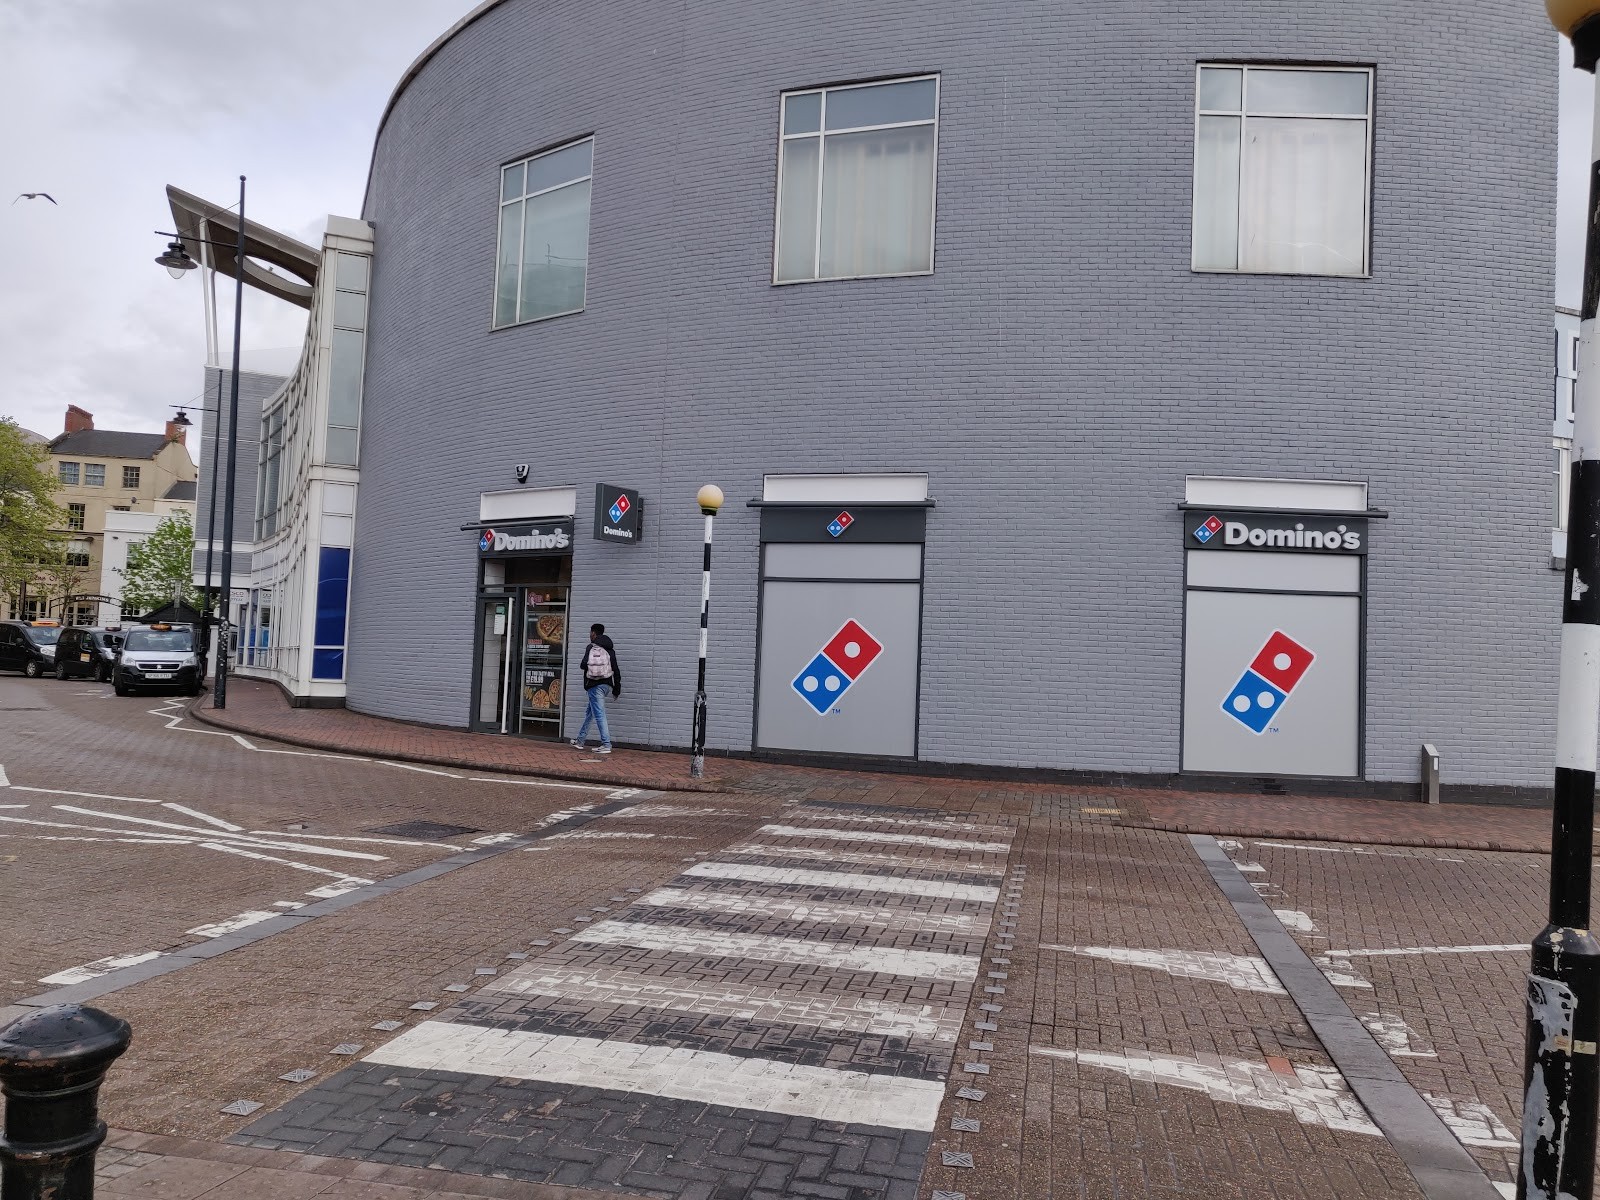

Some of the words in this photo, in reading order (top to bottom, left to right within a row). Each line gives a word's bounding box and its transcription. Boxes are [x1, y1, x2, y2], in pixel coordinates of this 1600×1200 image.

[494, 528, 570, 551] Domino's
[603, 525, 633, 539] Domino's
[1224, 521, 1361, 550] Domino's
